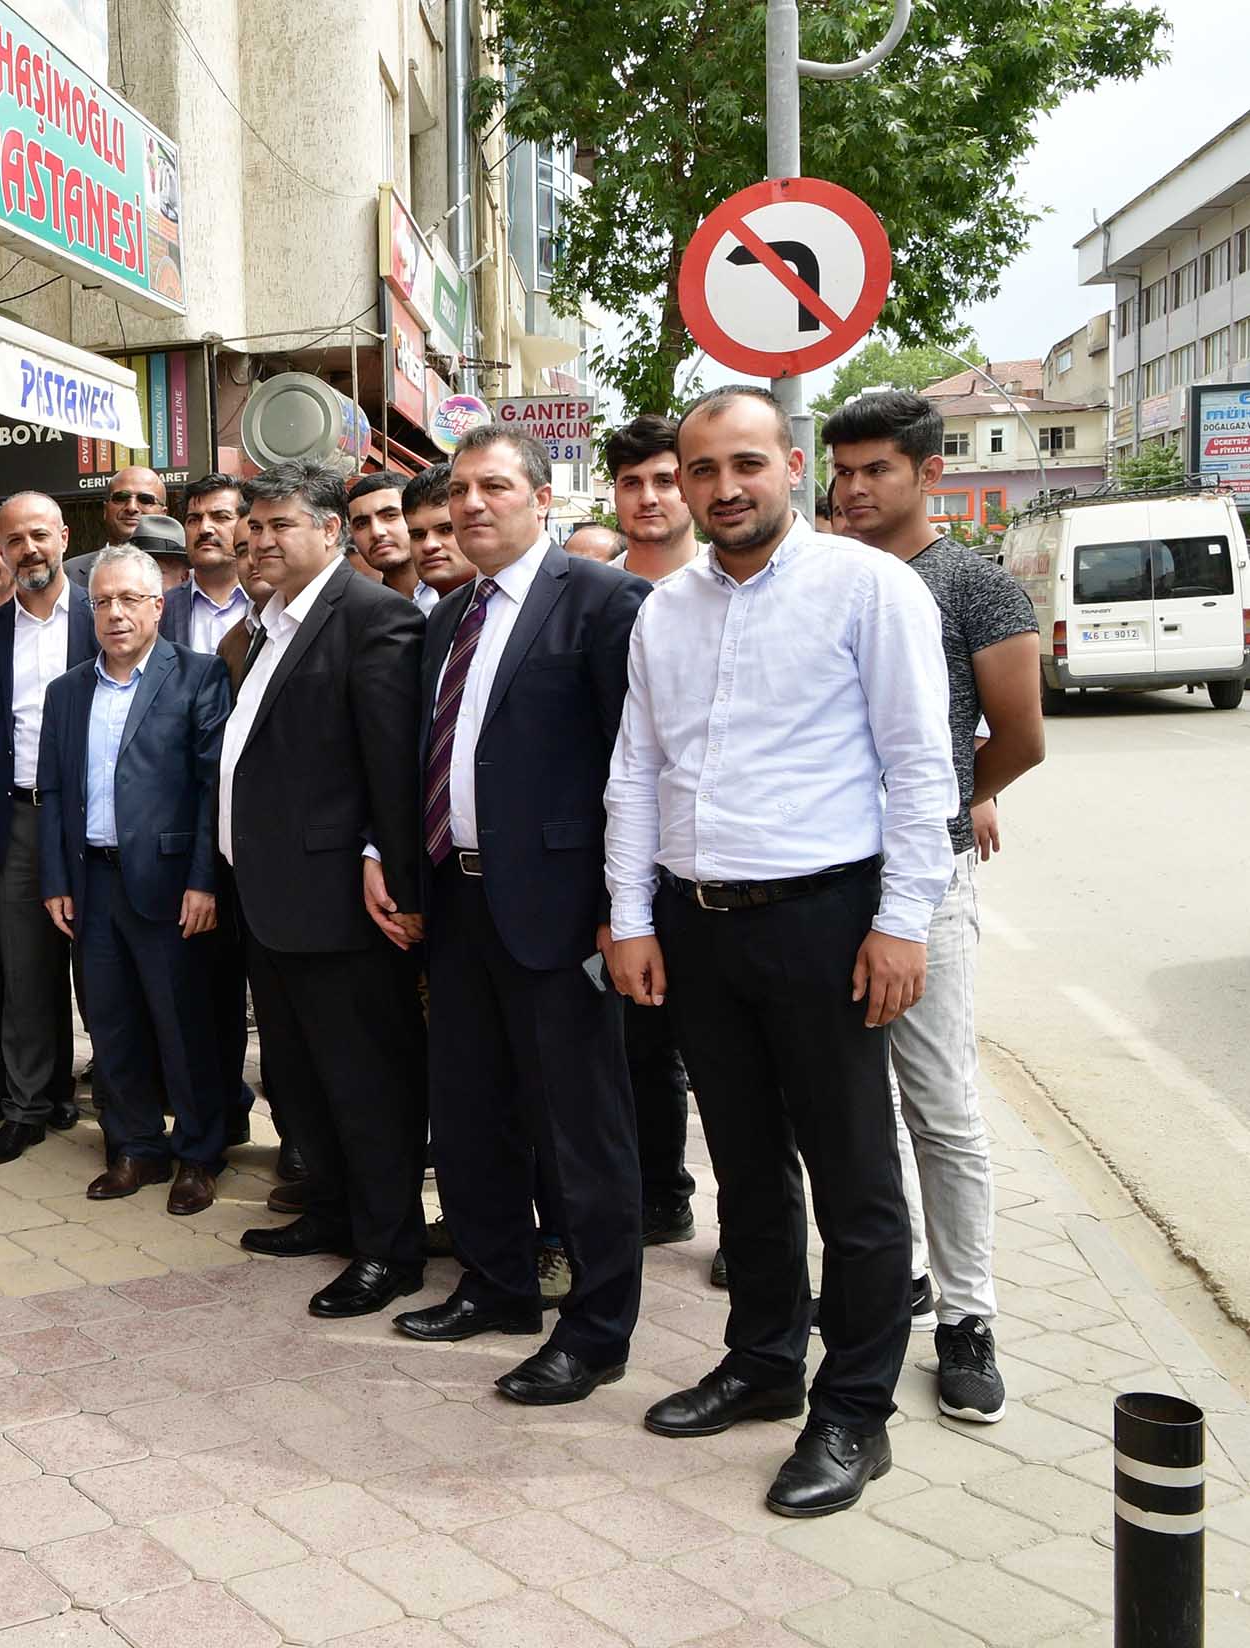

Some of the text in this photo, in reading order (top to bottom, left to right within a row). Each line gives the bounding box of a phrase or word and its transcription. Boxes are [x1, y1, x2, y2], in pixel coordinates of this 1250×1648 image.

[501, 402, 590, 421] G.ANTEP
[174, 390, 183, 457] SINTET LINE
[521, 422, 590, 439] MACUN
[565, 445, 582, 460] 81
